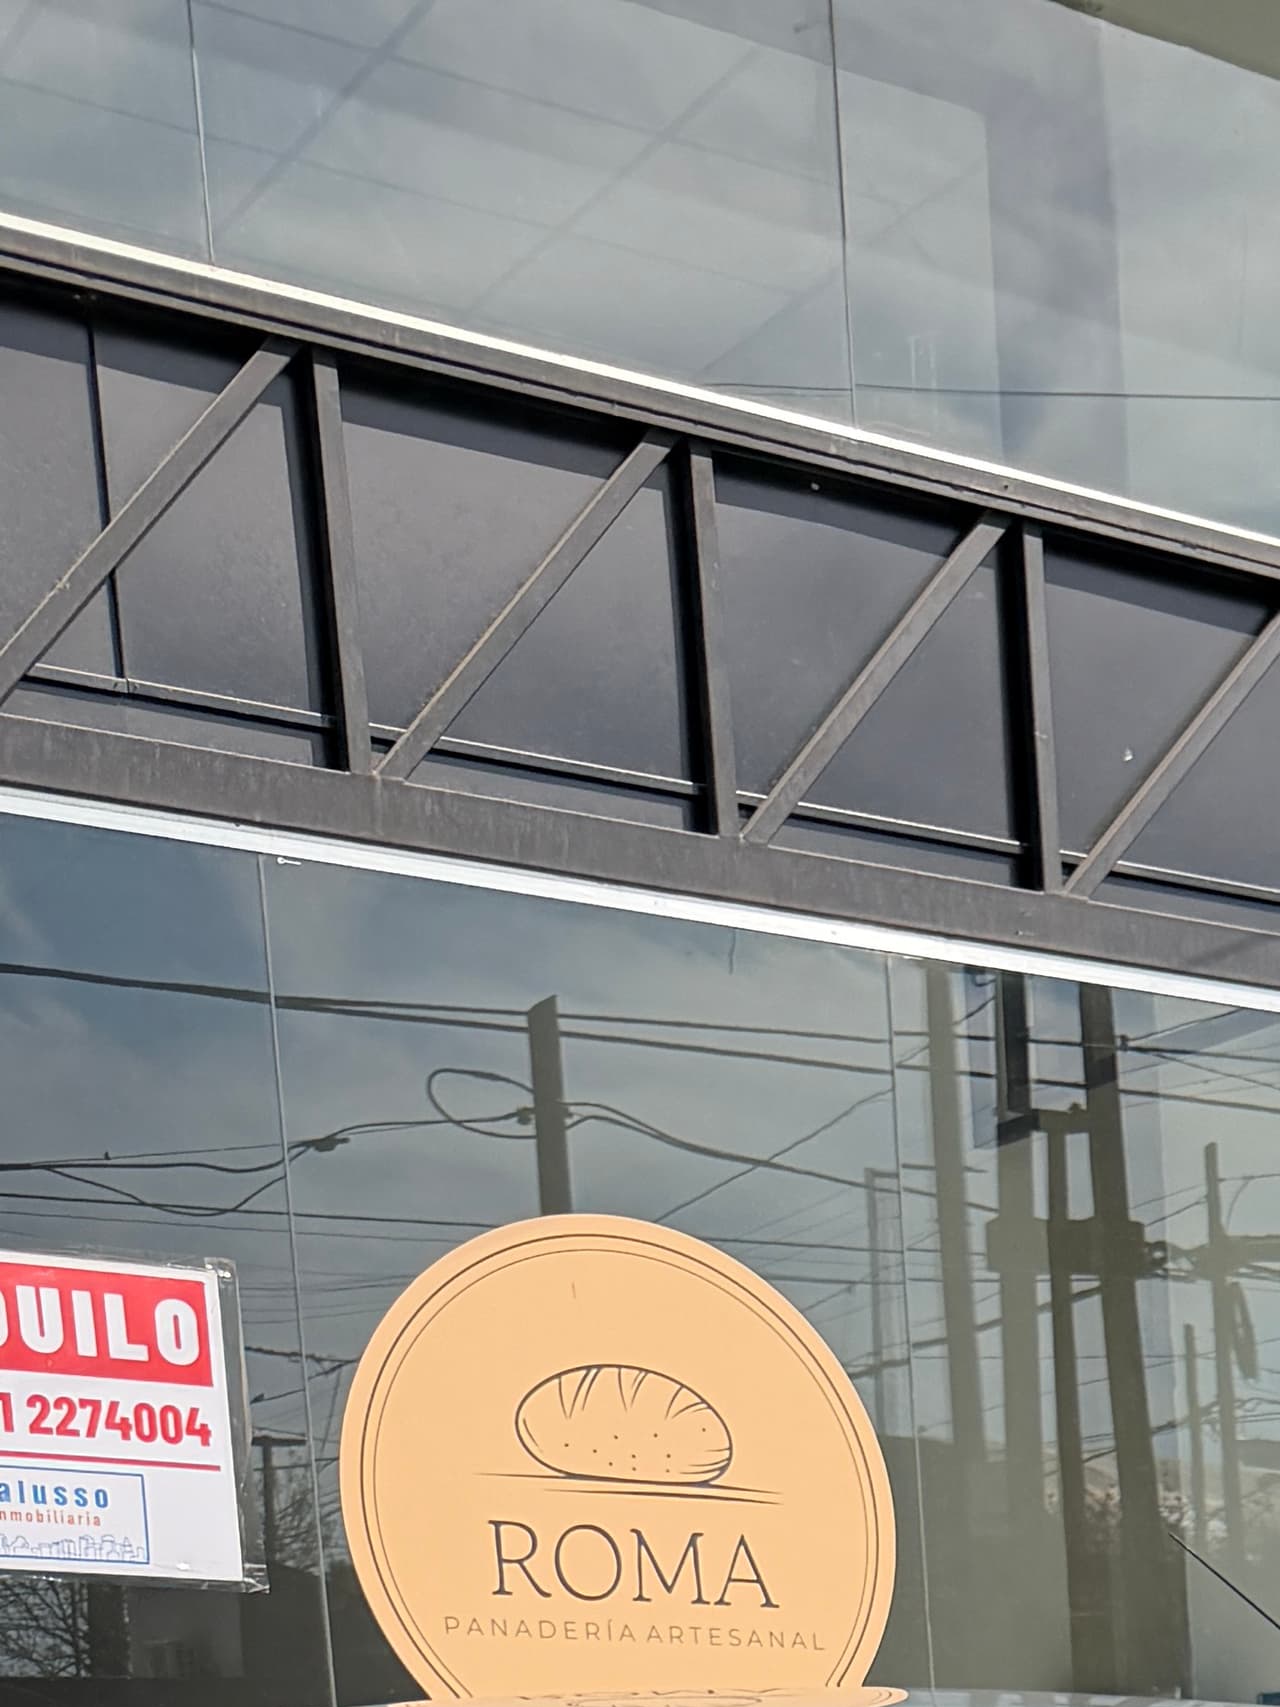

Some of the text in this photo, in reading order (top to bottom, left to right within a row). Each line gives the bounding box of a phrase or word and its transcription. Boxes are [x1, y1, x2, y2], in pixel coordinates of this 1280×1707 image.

[26, 1394, 212, 1448] 2274004
[488, 1519, 780, 1609] ROMA
[444, 1616, 827, 1652] PANADERÍA ARTESANAL
